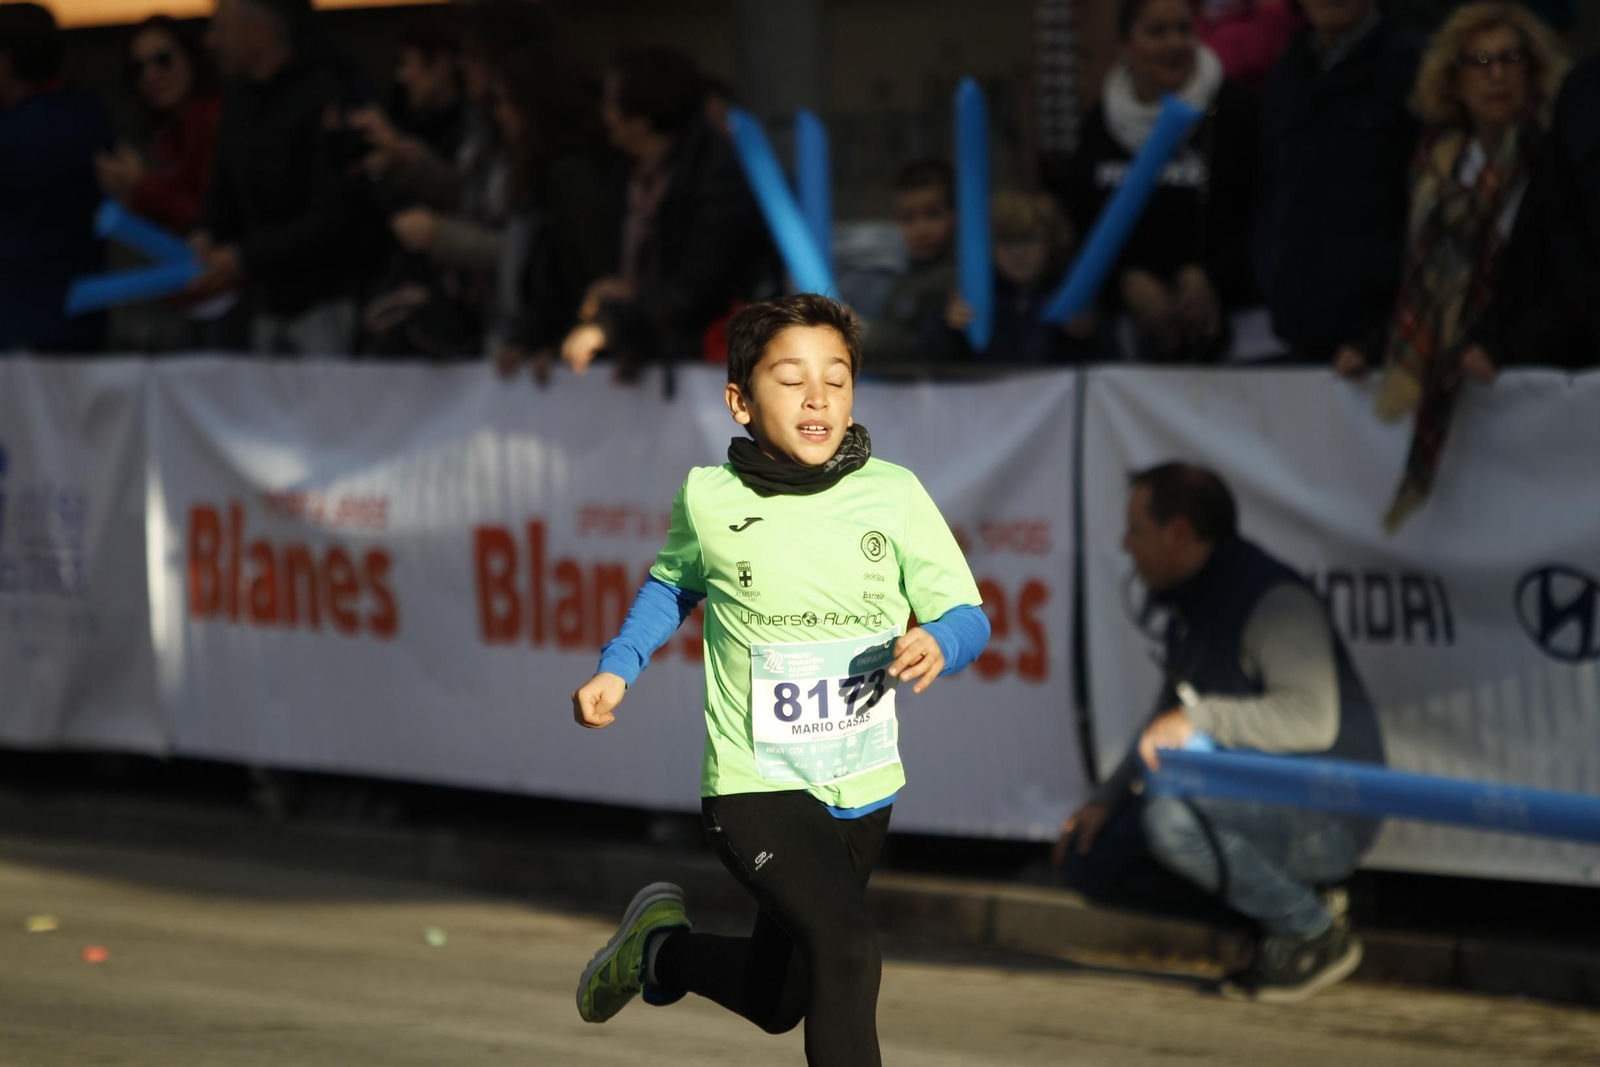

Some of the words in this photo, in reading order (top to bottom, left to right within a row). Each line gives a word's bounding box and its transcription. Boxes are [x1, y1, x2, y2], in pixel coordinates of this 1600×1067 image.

[188, 501, 399, 642] Blanes
[774, 669, 886, 722] 8173
[791, 721, 834, 735] MARIO
[838, 713, 871, 730] CASAS
